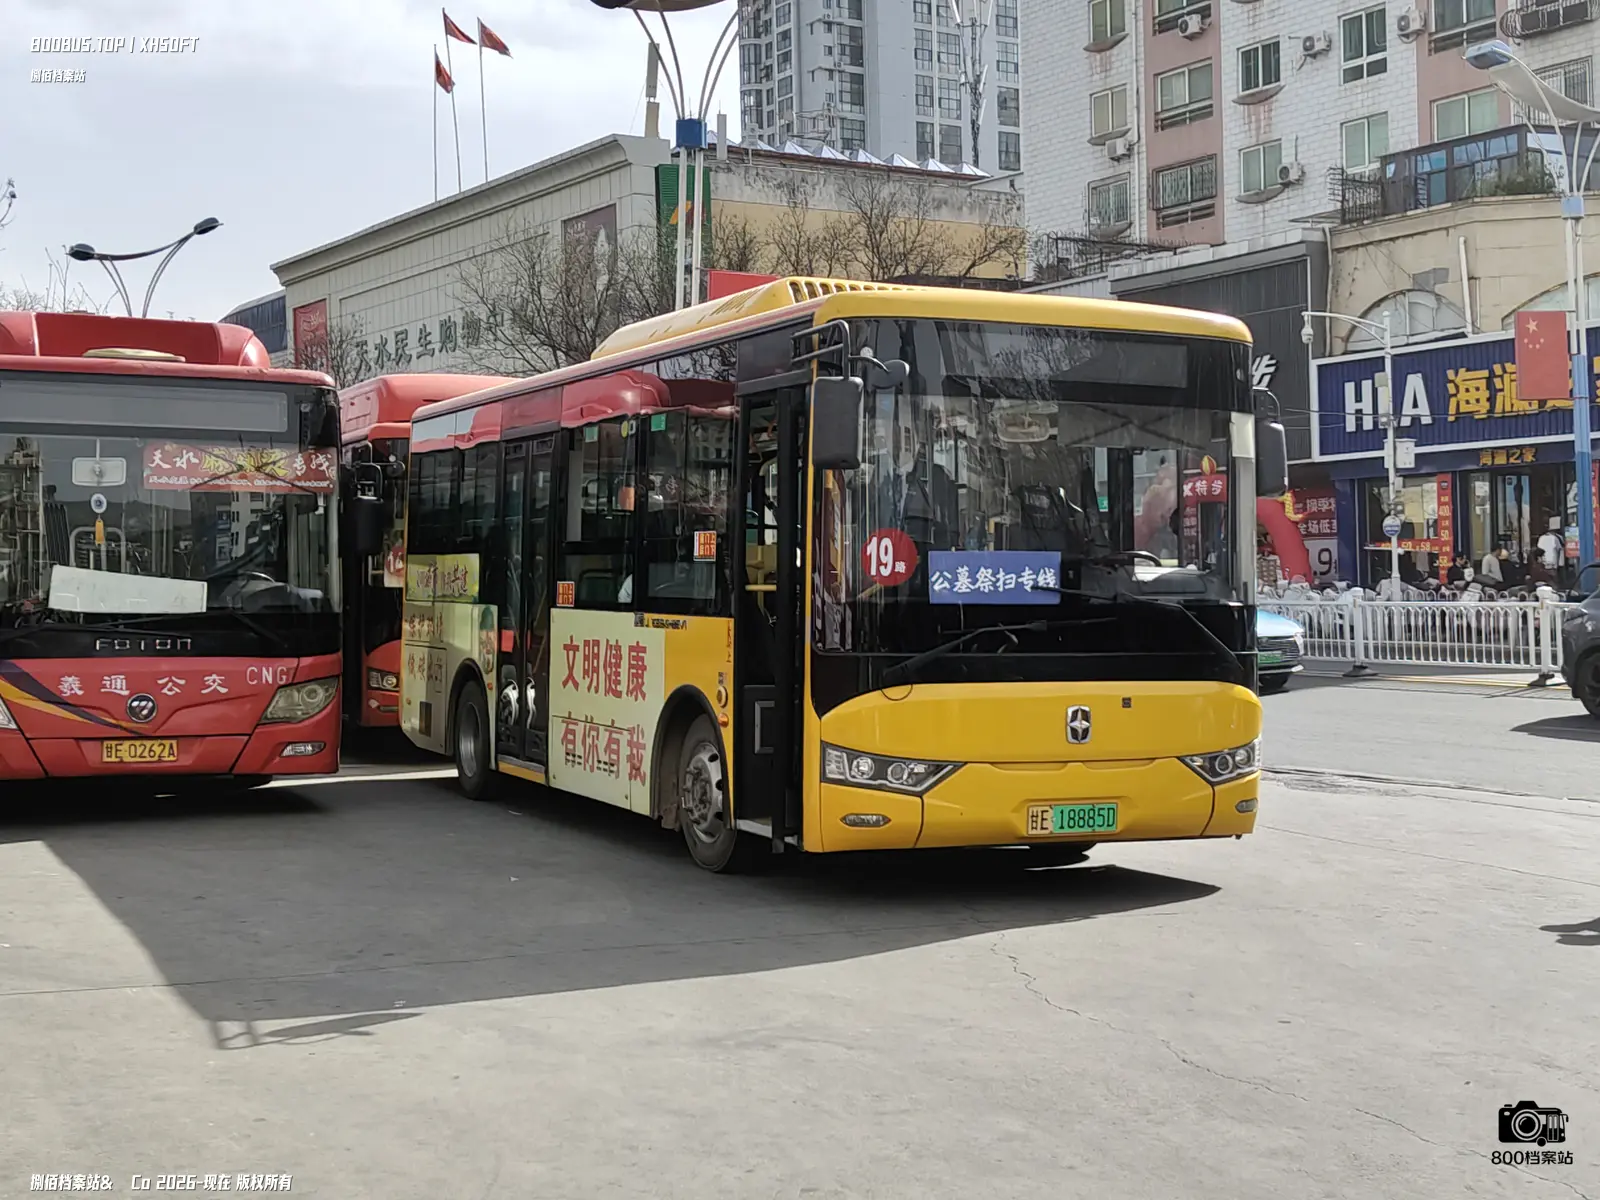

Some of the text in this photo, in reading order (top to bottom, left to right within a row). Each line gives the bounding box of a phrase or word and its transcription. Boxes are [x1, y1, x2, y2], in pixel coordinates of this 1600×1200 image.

[930, 564, 1059, 593] 公墓祭扫专线
[246, 666, 290, 685] CNG
[561, 634, 648, 702] 文明健康
[560, 710, 648, 788] 有你有我
